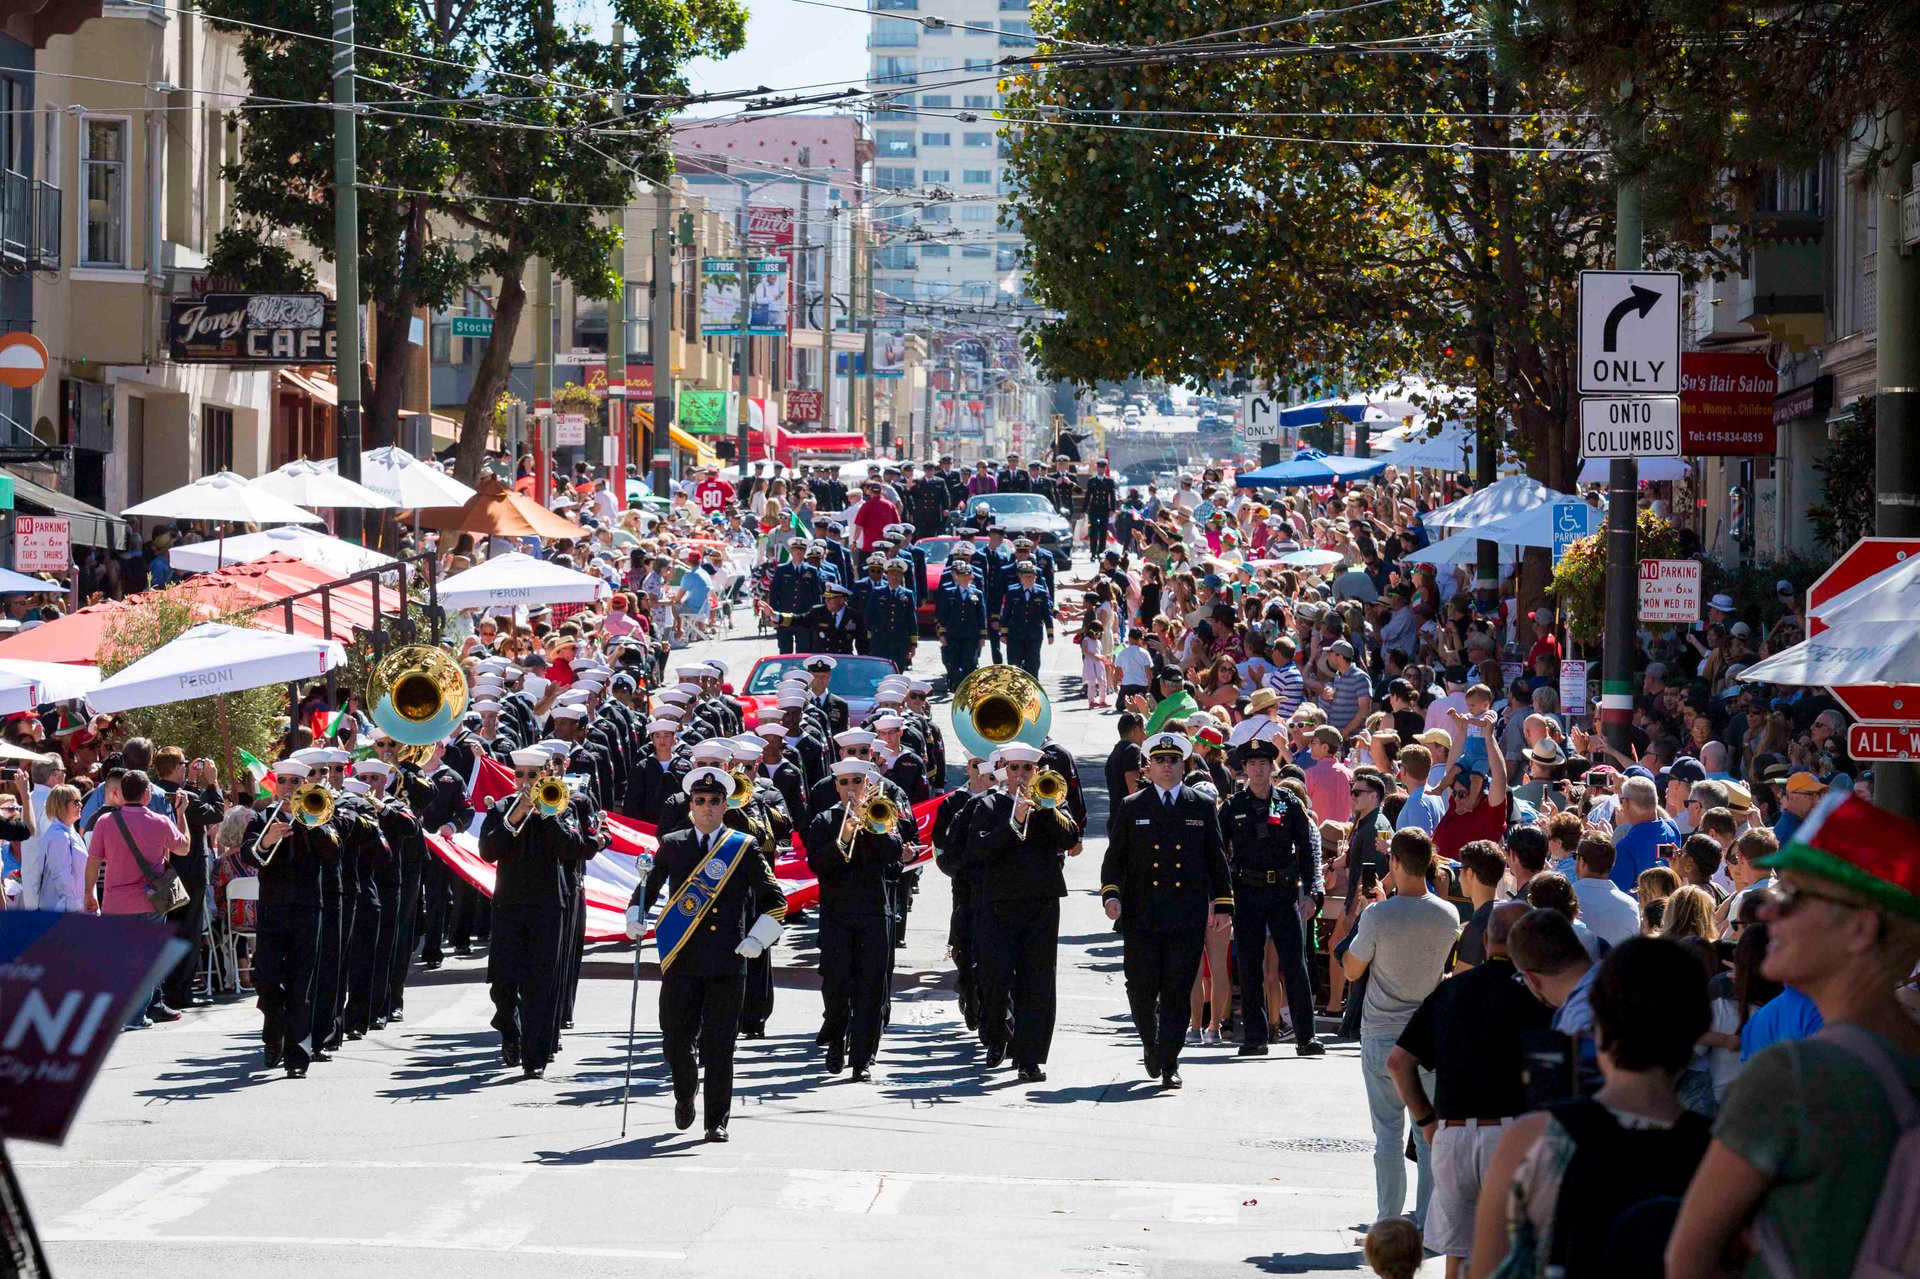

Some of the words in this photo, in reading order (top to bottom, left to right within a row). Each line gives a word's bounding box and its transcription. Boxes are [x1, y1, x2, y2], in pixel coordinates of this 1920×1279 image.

[177, 306, 246, 343] Tony
[1593, 360, 1665, 383] ONLY
[1681, 374, 1706, 391] Su's
[1709, 374, 1736, 392] Hair
[1738, 375, 1773, 392] Salon
[1610, 404, 1651, 424] ONTO
[1702, 402, 1732, 415] Women
[1739, 403, 1772, 415] Children
[1247, 426, 1275, 436] ONLY
[1689, 431, 1704, 441] Tel:
[1706, 432, 1763, 442] 415-834-0519
[1588, 430, 1674, 451] COLUMBUS
[703, 490, 722, 508] 80
[18, 519, 31, 532] NO
[35, 523, 66, 533] PARKING
[22, 551, 37, 559] TUES
[44, 551, 63, 559] THURS
[1641, 563, 1657, 578] NO
[1662, 566, 1696, 578] PARKING
[489, 588, 530, 598] PERONI
[1643, 599, 1659, 608] MON
[1664, 599, 1679, 608] WED
[1684, 600, 1695, 609] FRI
[179, 669, 234, 688] PERONI
[1858, 732, 1897, 753] ALL
